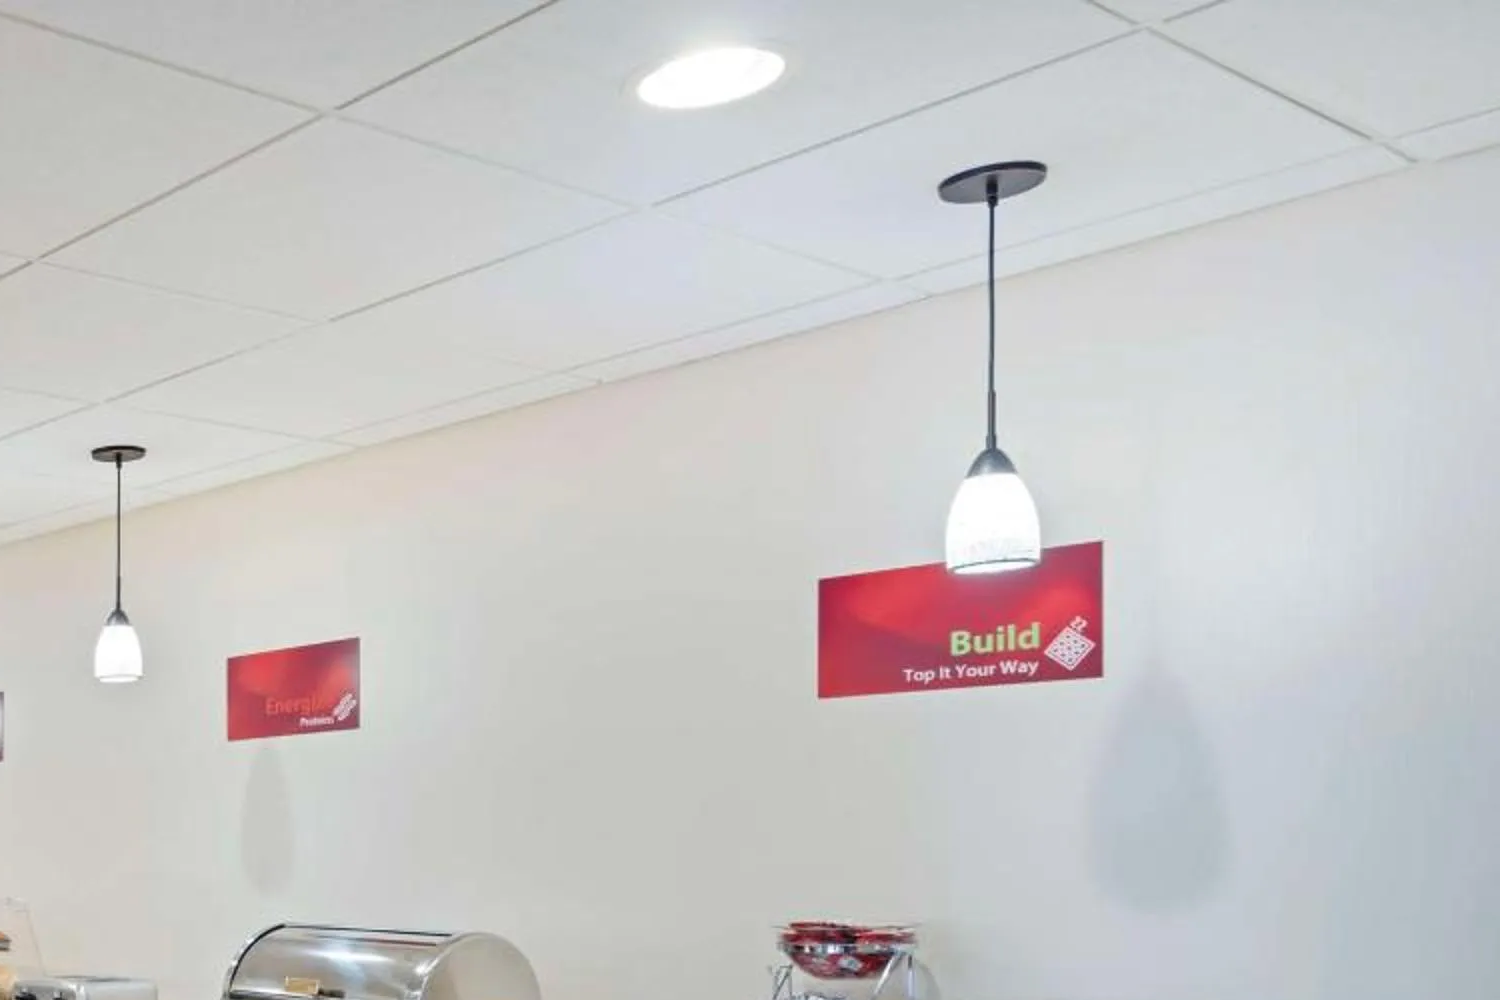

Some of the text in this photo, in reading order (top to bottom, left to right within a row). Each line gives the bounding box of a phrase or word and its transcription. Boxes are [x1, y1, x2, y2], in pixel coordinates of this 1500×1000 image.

[950, 621, 1041, 656] Build
[903, 660, 1039, 685] Top It Your Way
